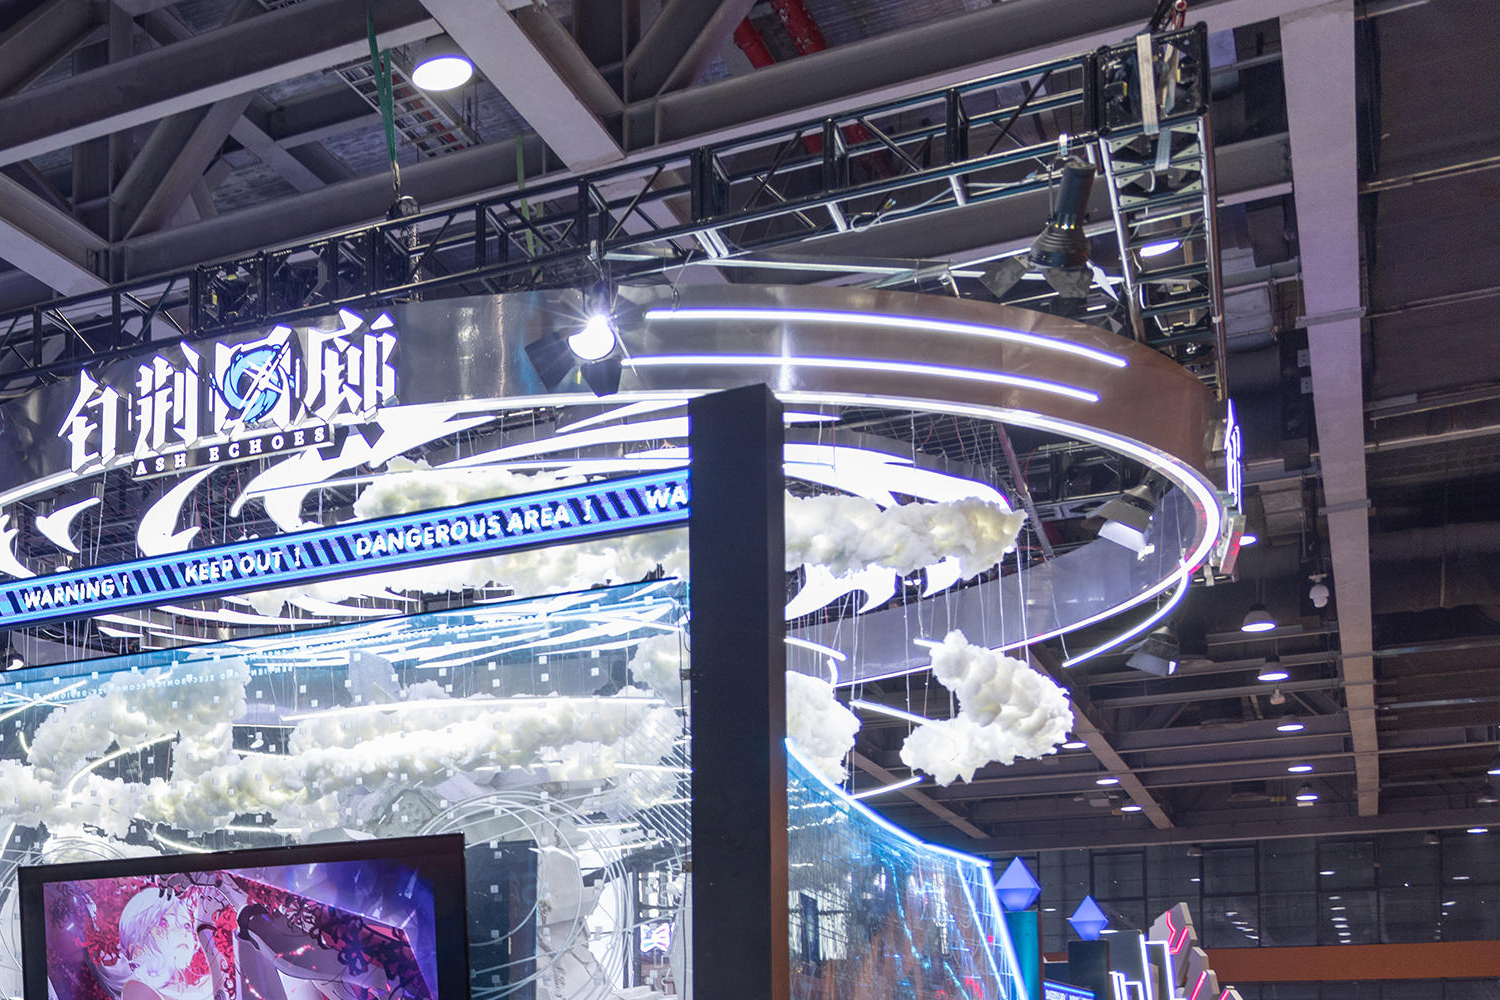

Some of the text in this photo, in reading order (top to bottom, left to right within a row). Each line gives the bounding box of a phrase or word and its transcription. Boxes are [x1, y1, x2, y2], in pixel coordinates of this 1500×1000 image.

[136, 426, 326, 476] ASH ECHOES
[24, 577, 116, 611] WARNING
[185, 558, 232, 584] KEEP
[238, 552, 283, 575] OUT
[356, 514, 502, 556] DANGEROUS
[506, 505, 571, 534] AREA
